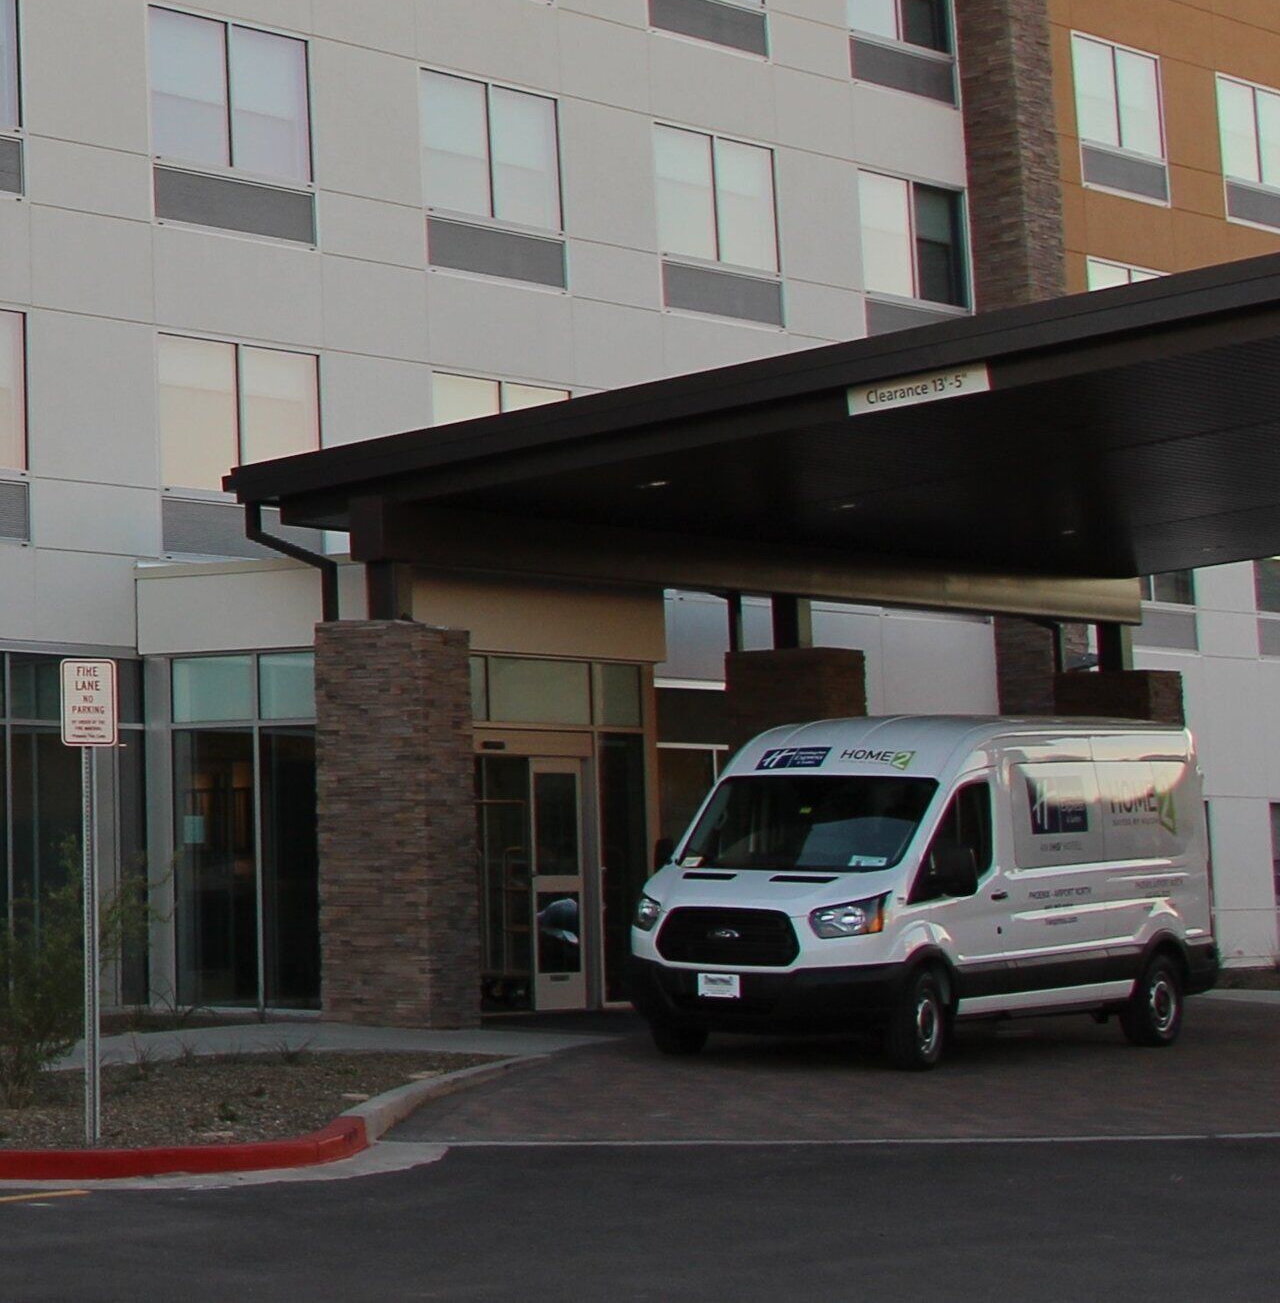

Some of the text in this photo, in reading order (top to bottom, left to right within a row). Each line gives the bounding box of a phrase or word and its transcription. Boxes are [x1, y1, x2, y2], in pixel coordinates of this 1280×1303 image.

[866, 383, 929, 404] Clearance
[76, 666, 99, 677] FIRE
[75, 680, 100, 691] LANE
[83, 695, 94, 703] NO
[72, 706, 105, 714] PARKING
